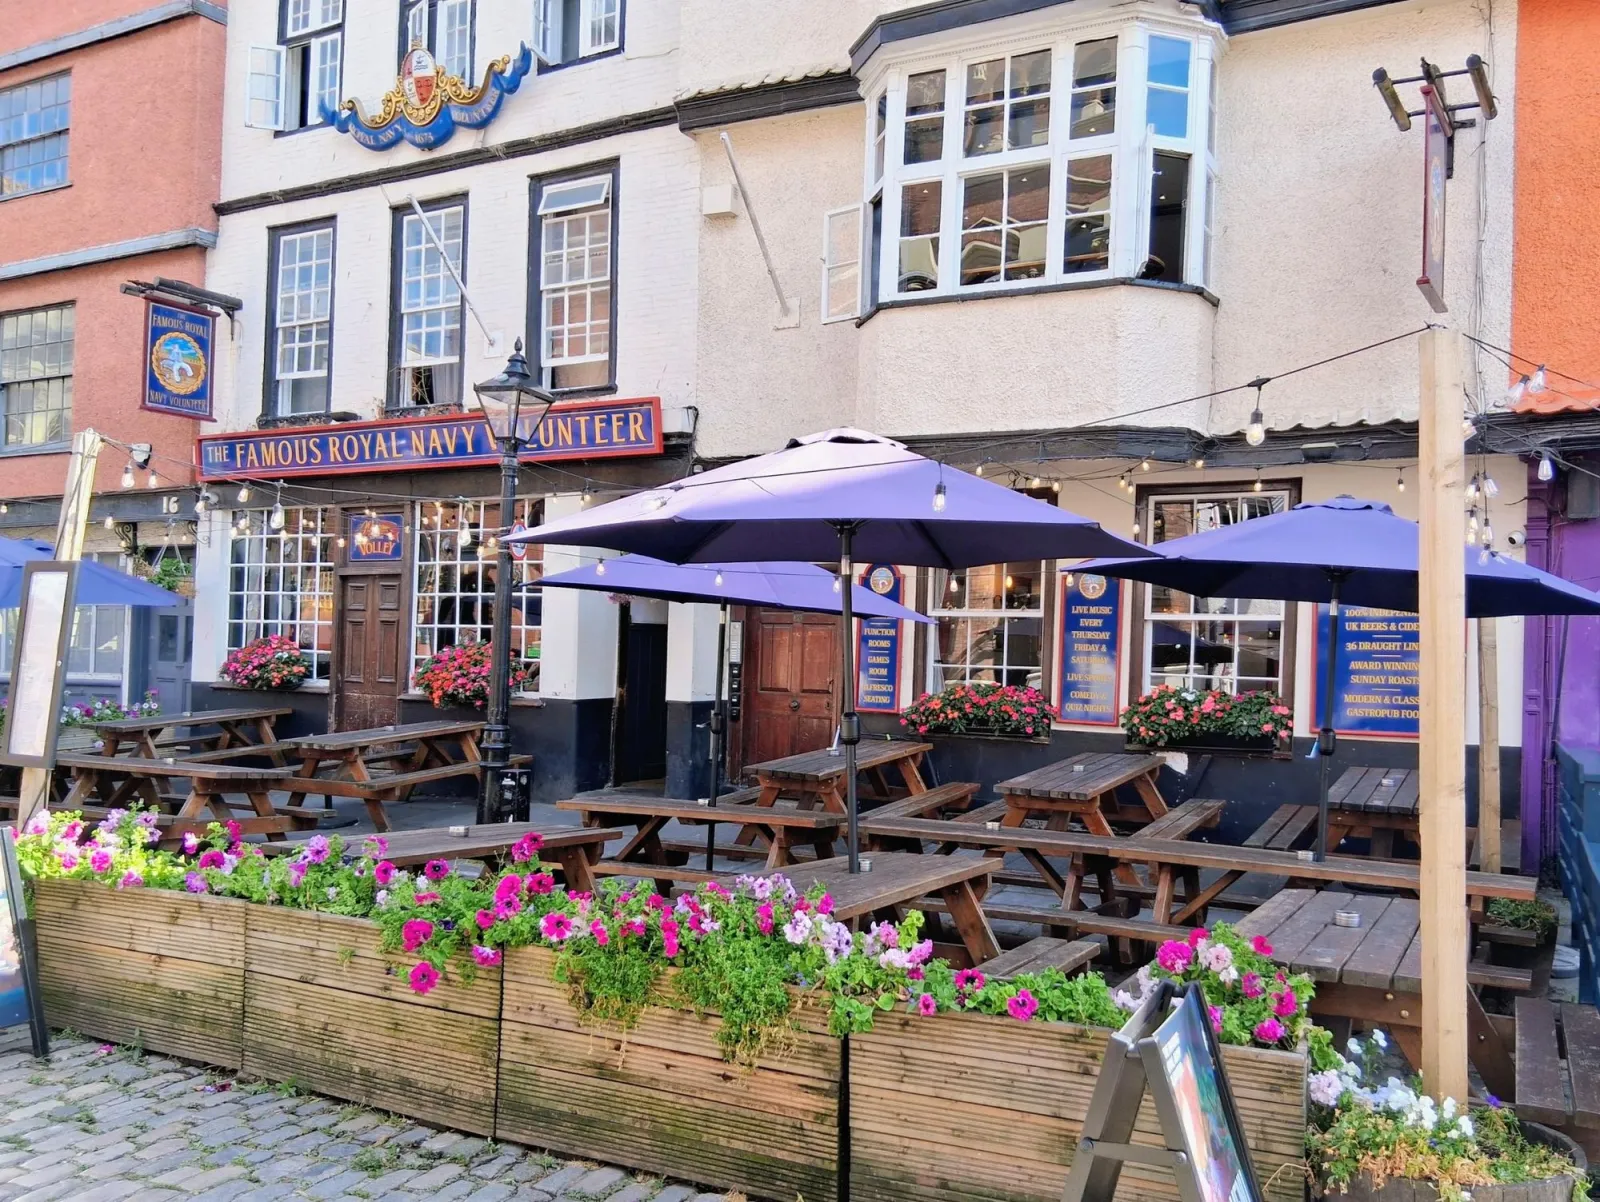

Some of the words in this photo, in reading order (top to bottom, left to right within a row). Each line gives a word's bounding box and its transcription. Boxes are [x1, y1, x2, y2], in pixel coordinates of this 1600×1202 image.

[152, 314, 184, 330] FAMOUS
[185, 323, 208, 339] ROYAL
[149, 390, 168, 405] NAVY
[169, 395, 206, 411] VOLUNTEER
[207, 445, 230, 463] THE
[235, 437, 322, 468] FAMOUS
[328, 430, 404, 462] ROYAL
[411, 425, 476, 457] NAVY
[162, 496, 179, 514] 16
[1072, 606, 1088, 614] LIVE
[1089, 606, 1112, 614] MUSIC
[1080, 618, 1103, 627] EVERY
[1345, 622, 1359, 631] UK
[1360, 622, 1388, 631] BEERS
[1389, 622, 1397, 631] &
[864, 627, 896, 636] FUNCTION
[1072, 631, 1110, 640] THURSDAY
[868, 640, 891, 648] ROOMS
[1074, 644, 1100, 652] FRIDAY
[1100, 644, 1107, 652] &
[1345, 642, 1357, 652] 36
[1358, 642, 1402, 650] DRAUGHT
[868, 656, 890, 664] GAMES
[1071, 656, 1108, 664] SATURDAY
[1349, 661, 1382, 670] AWARD
[868, 668, 888, 676] ROOM
[1067, 672, 1084, 681] LIVE
[1350, 675, 1387, 684] SUNDAY
[863, 695, 890, 704] SEATING
[1344, 694, 1382, 704] MODERN
[1383, 696, 1390, 704] &
[1346, 708, 1400, 718] GASTROPUB
